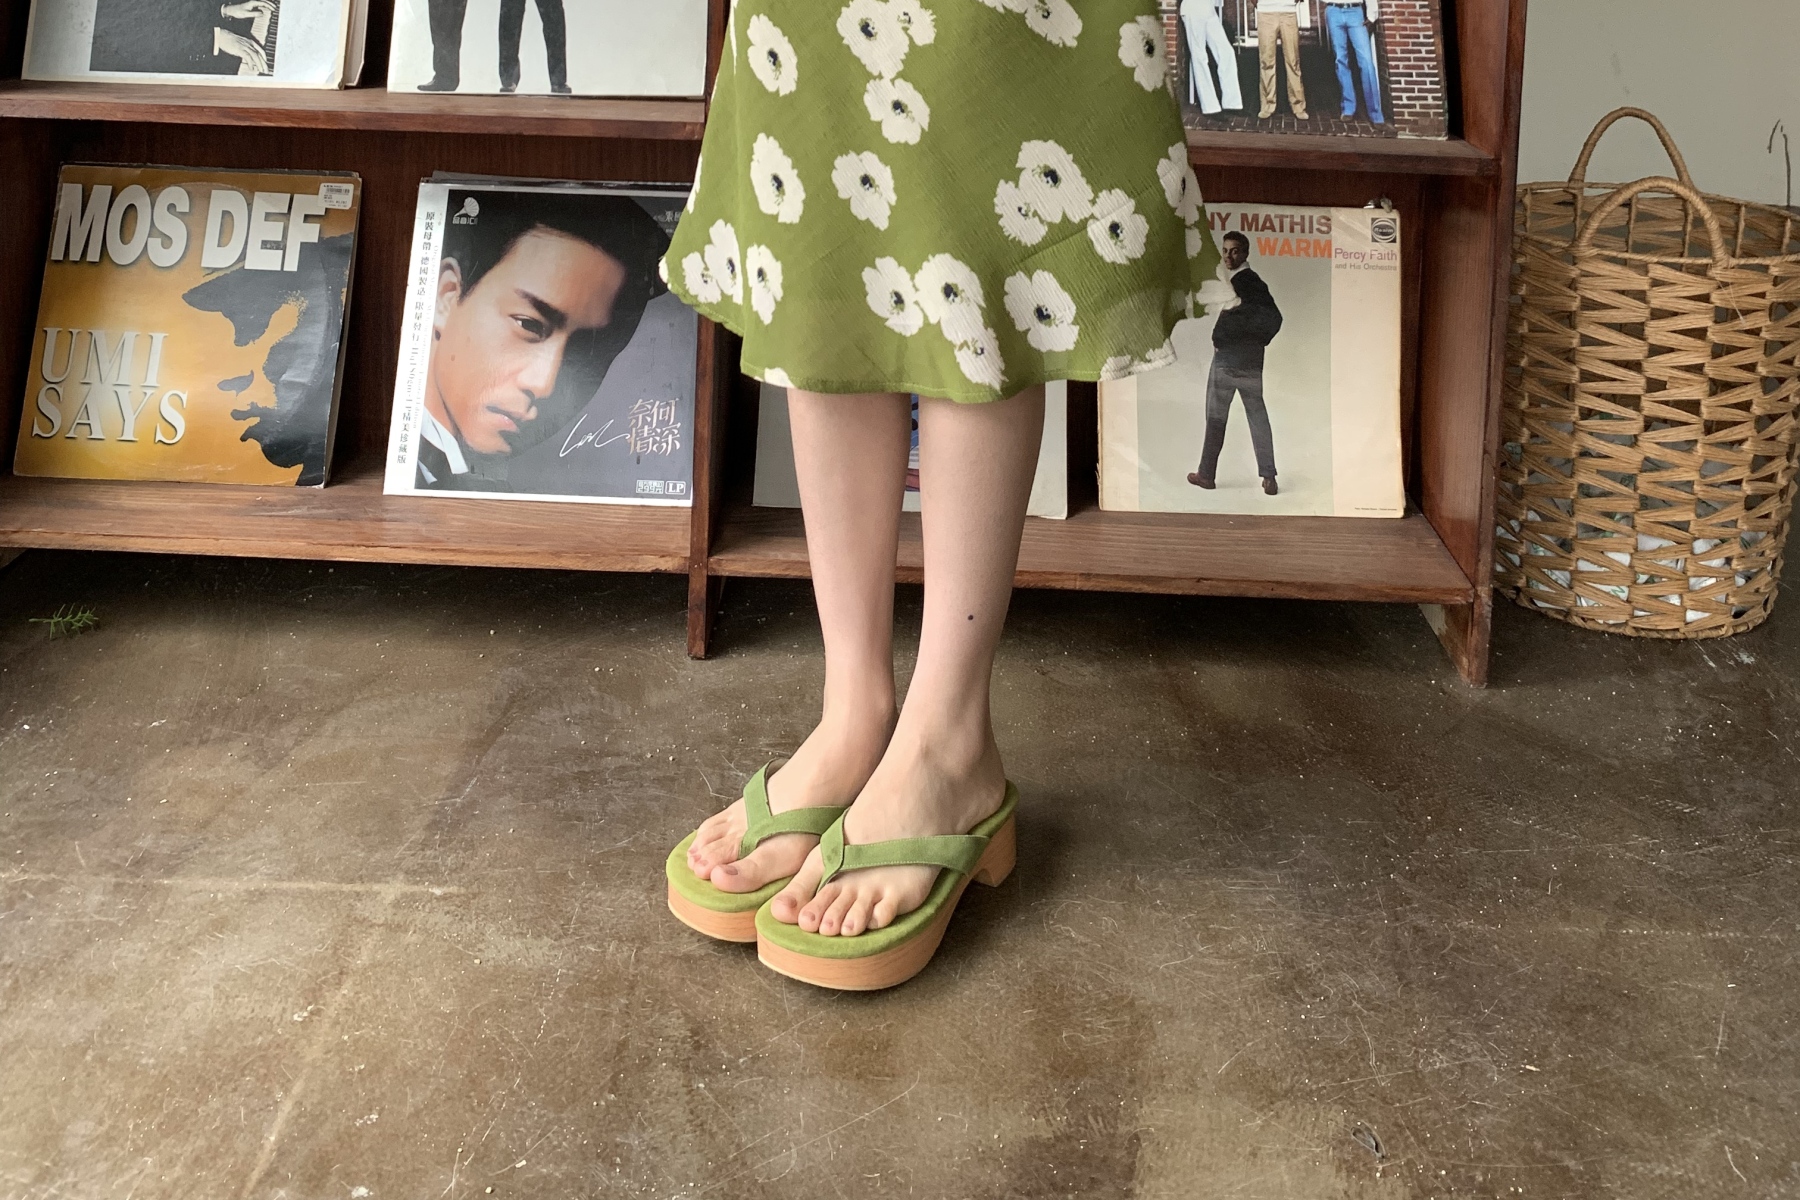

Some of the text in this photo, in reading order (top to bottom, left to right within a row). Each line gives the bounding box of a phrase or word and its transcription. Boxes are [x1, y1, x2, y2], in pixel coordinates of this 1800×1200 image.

[51, 183, 325, 272] MOS DEF
[1240, 213, 1332, 234] MATHIS
[1256, 237, 1332, 259] WARM
[1334, 248, 1397, 262] Percy Faith
[1363, 263, 1397, 271] Orchestra
[42, 327, 169, 388] UMI
[31, 384, 189, 445] SAYS
[668, 482, 684, 493] LP
